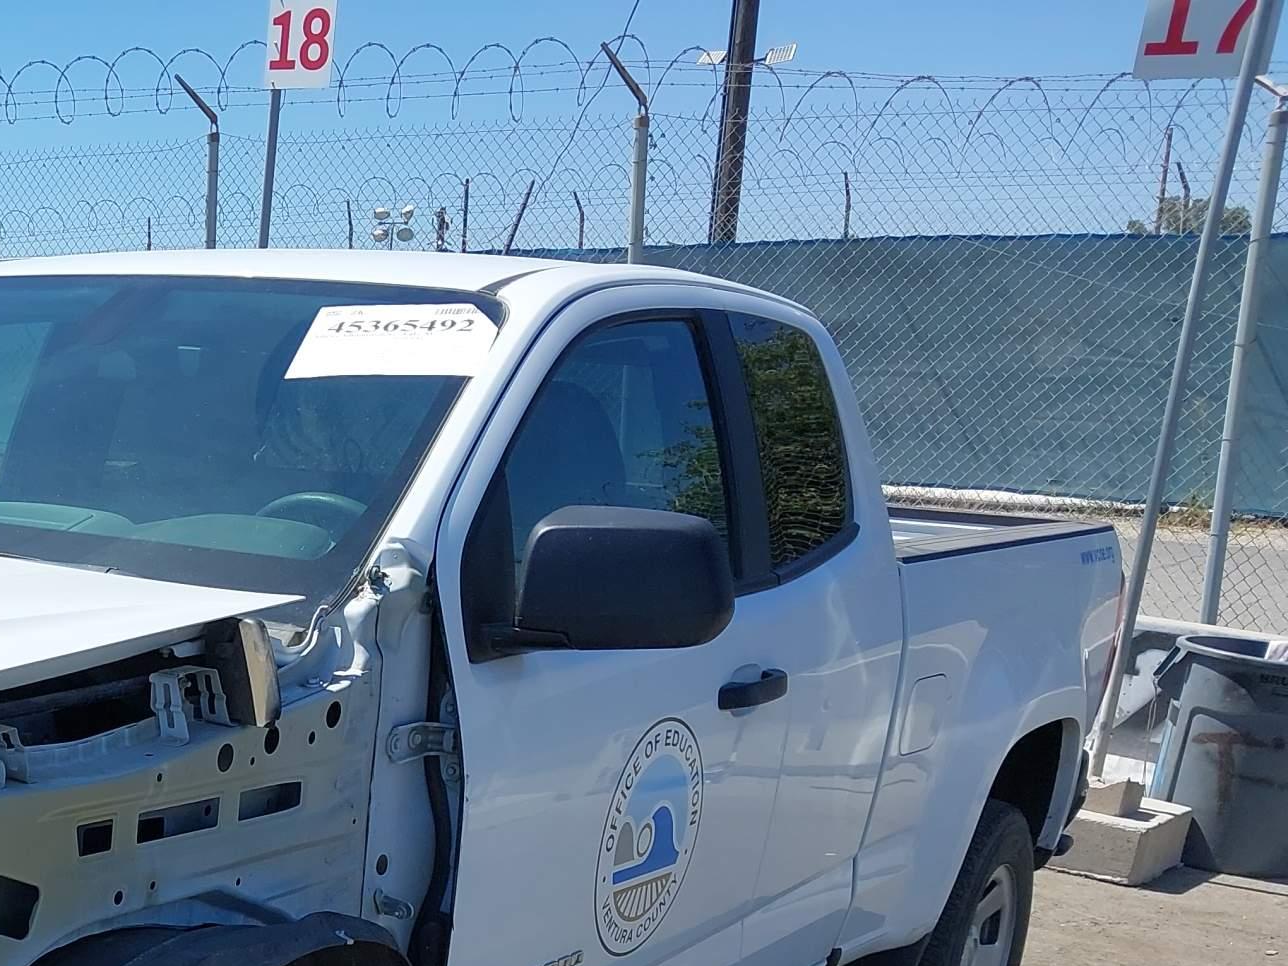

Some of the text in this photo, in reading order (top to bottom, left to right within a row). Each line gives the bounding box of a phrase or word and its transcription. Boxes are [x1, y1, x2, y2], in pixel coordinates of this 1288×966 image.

[269, 8, 331, 71] 18
[327, 318, 476, 334] 45365492
[605, 728, 700, 853] OFFICE OF EDUCATION
[601, 873, 678, 945] VENTURA COUNTY
